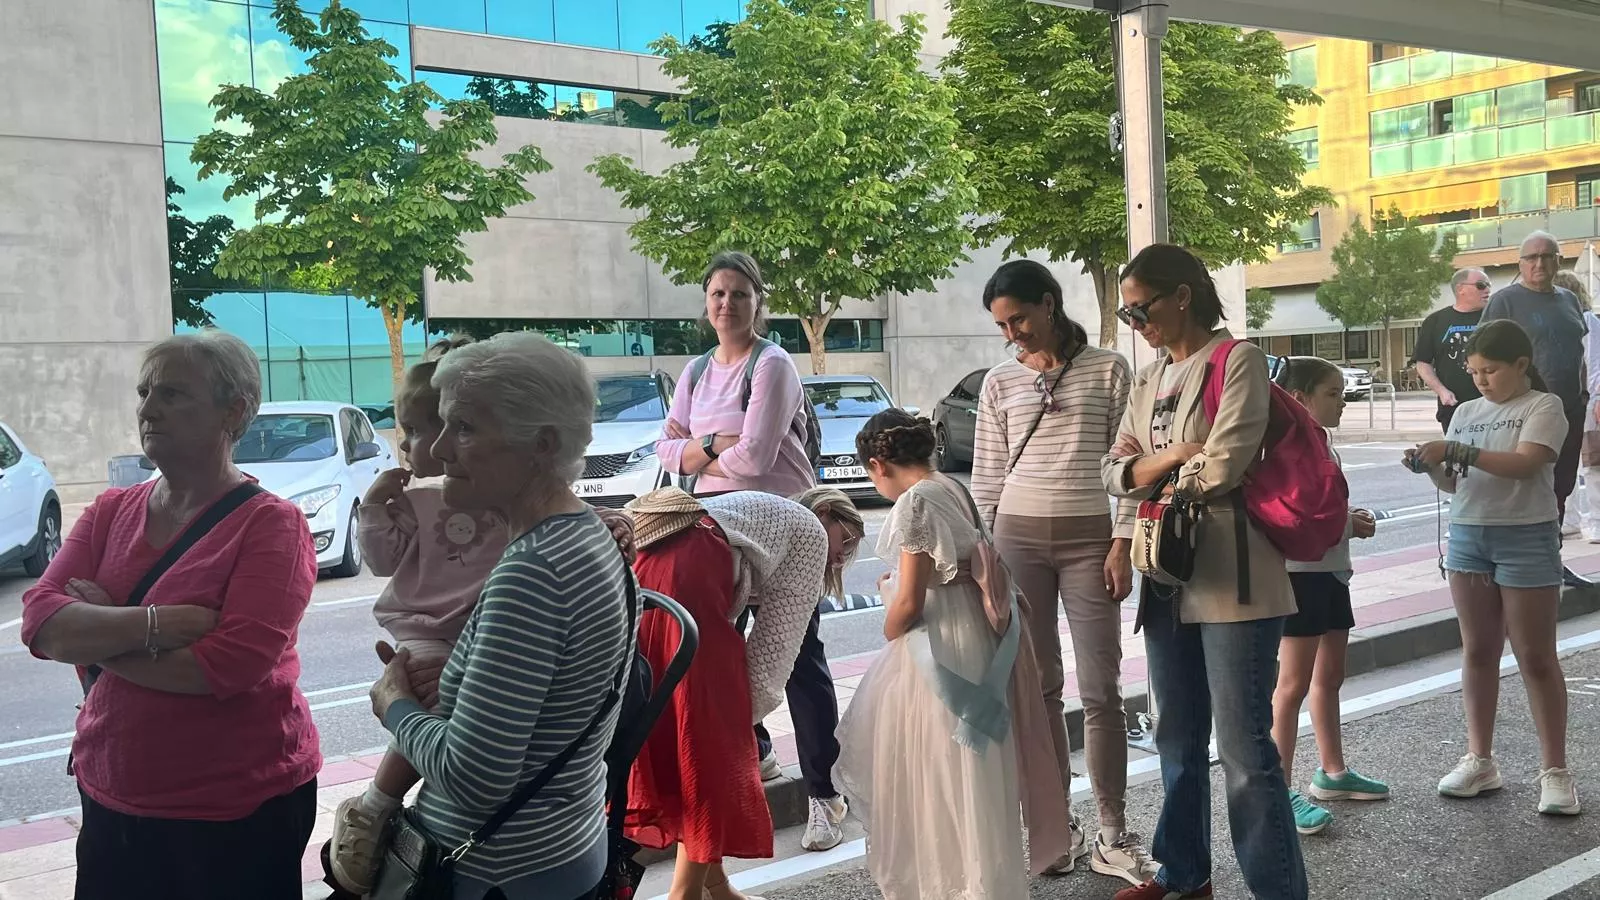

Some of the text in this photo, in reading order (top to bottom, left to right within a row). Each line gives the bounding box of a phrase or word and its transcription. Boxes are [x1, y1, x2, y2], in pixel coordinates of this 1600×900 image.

[1492, 418, 1523, 431] OPTIO
[826, 468, 849, 477] 2516
[583, 483, 603, 493] MNB
